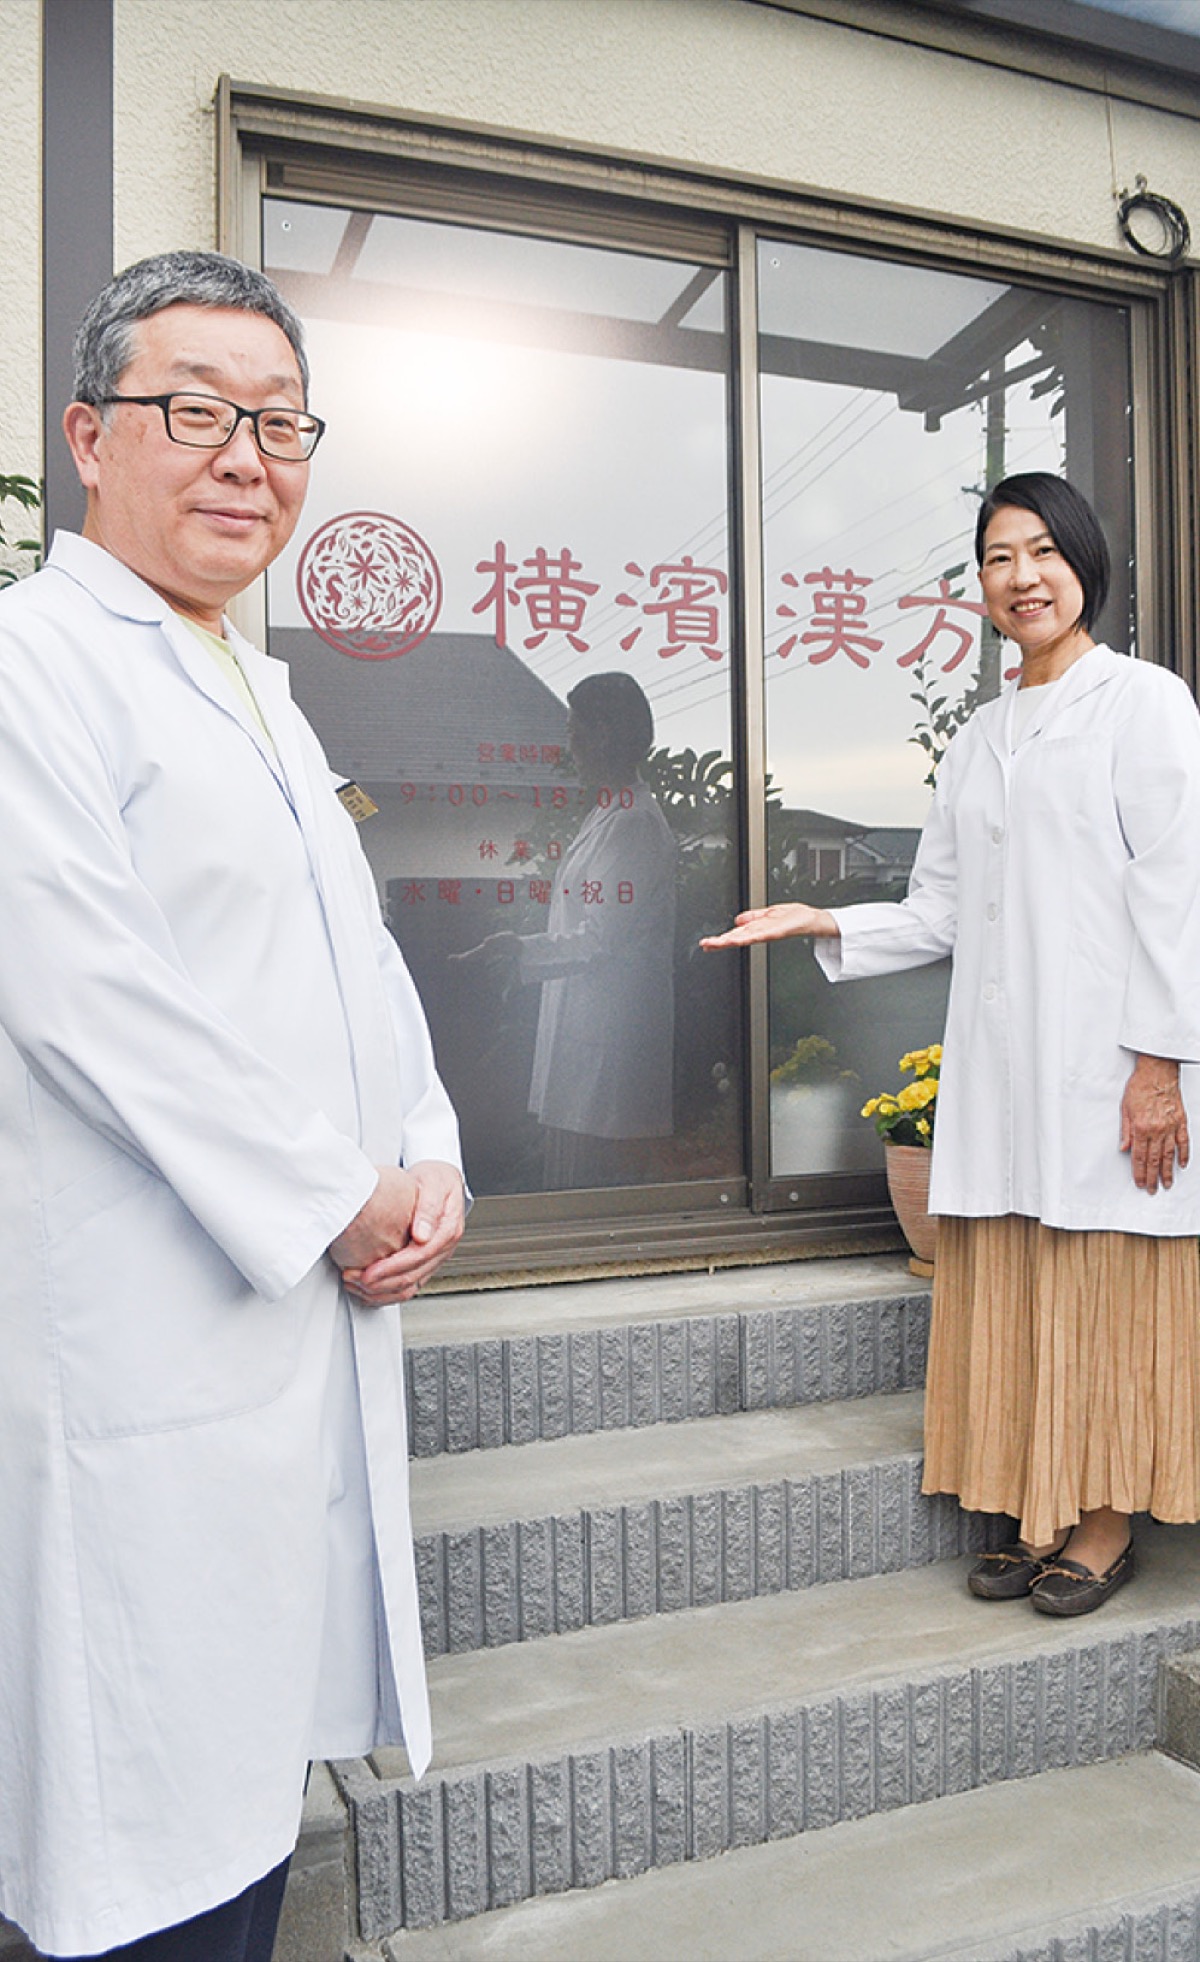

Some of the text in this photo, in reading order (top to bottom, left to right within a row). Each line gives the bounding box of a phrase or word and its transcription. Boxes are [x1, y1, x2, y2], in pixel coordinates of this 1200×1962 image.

[472, 540, 1024, 681] 横濱漢方
[478, 743, 561, 764] 営業時間
[479, 839, 562, 860] 休業日
